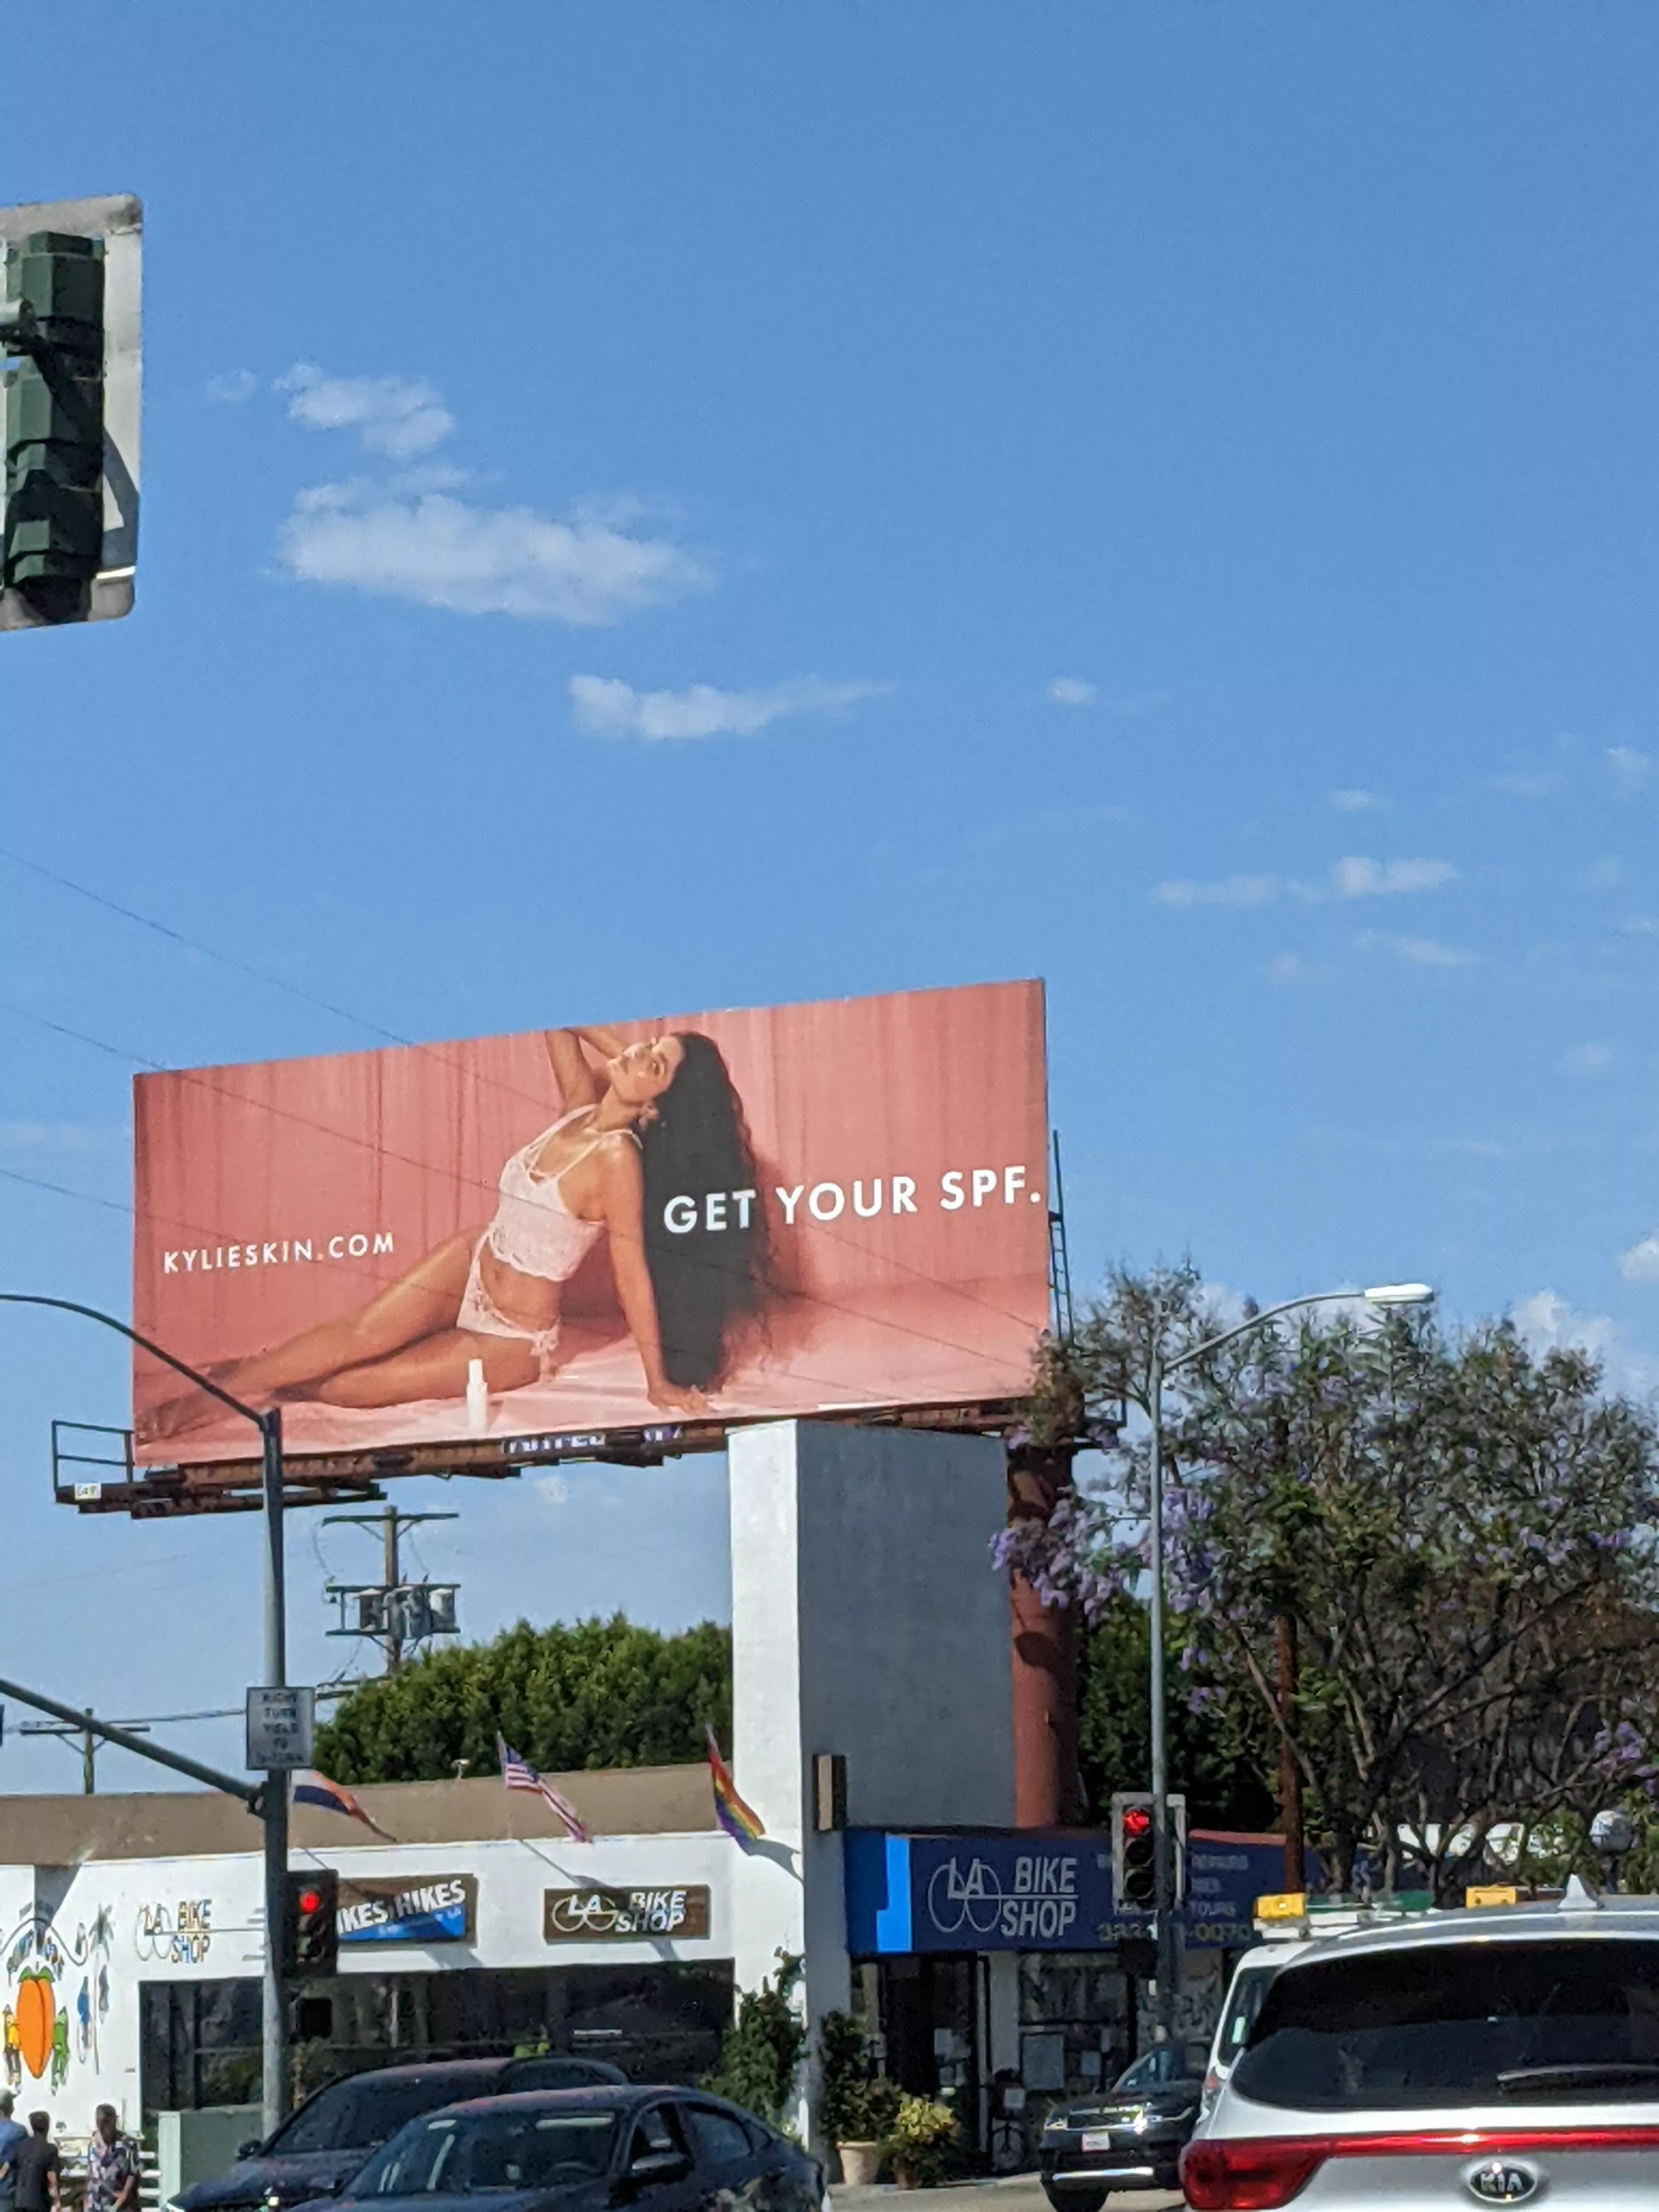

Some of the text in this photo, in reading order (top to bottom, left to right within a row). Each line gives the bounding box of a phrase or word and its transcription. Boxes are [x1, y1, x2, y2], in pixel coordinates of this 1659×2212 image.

[664, 1165, 1041, 1233] GET YOUR SPF.
[164, 1232, 394, 1274] KYLIESKIN.COM
[947, 1856, 1077, 1899] LA BIKE
[178, 1899, 213, 1930] BIKE
[336, 1900, 389, 1934] IKES
[395, 1879, 466, 1917] HIKES
[567, 1890, 687, 1916] LA BIKE
[1001, 1900, 1076, 1938] SHOP
[614, 1911, 686, 1932] SHOP
[171, 1934, 211, 1964] SHOP
[1480, 2172, 1525, 2193] KIA
